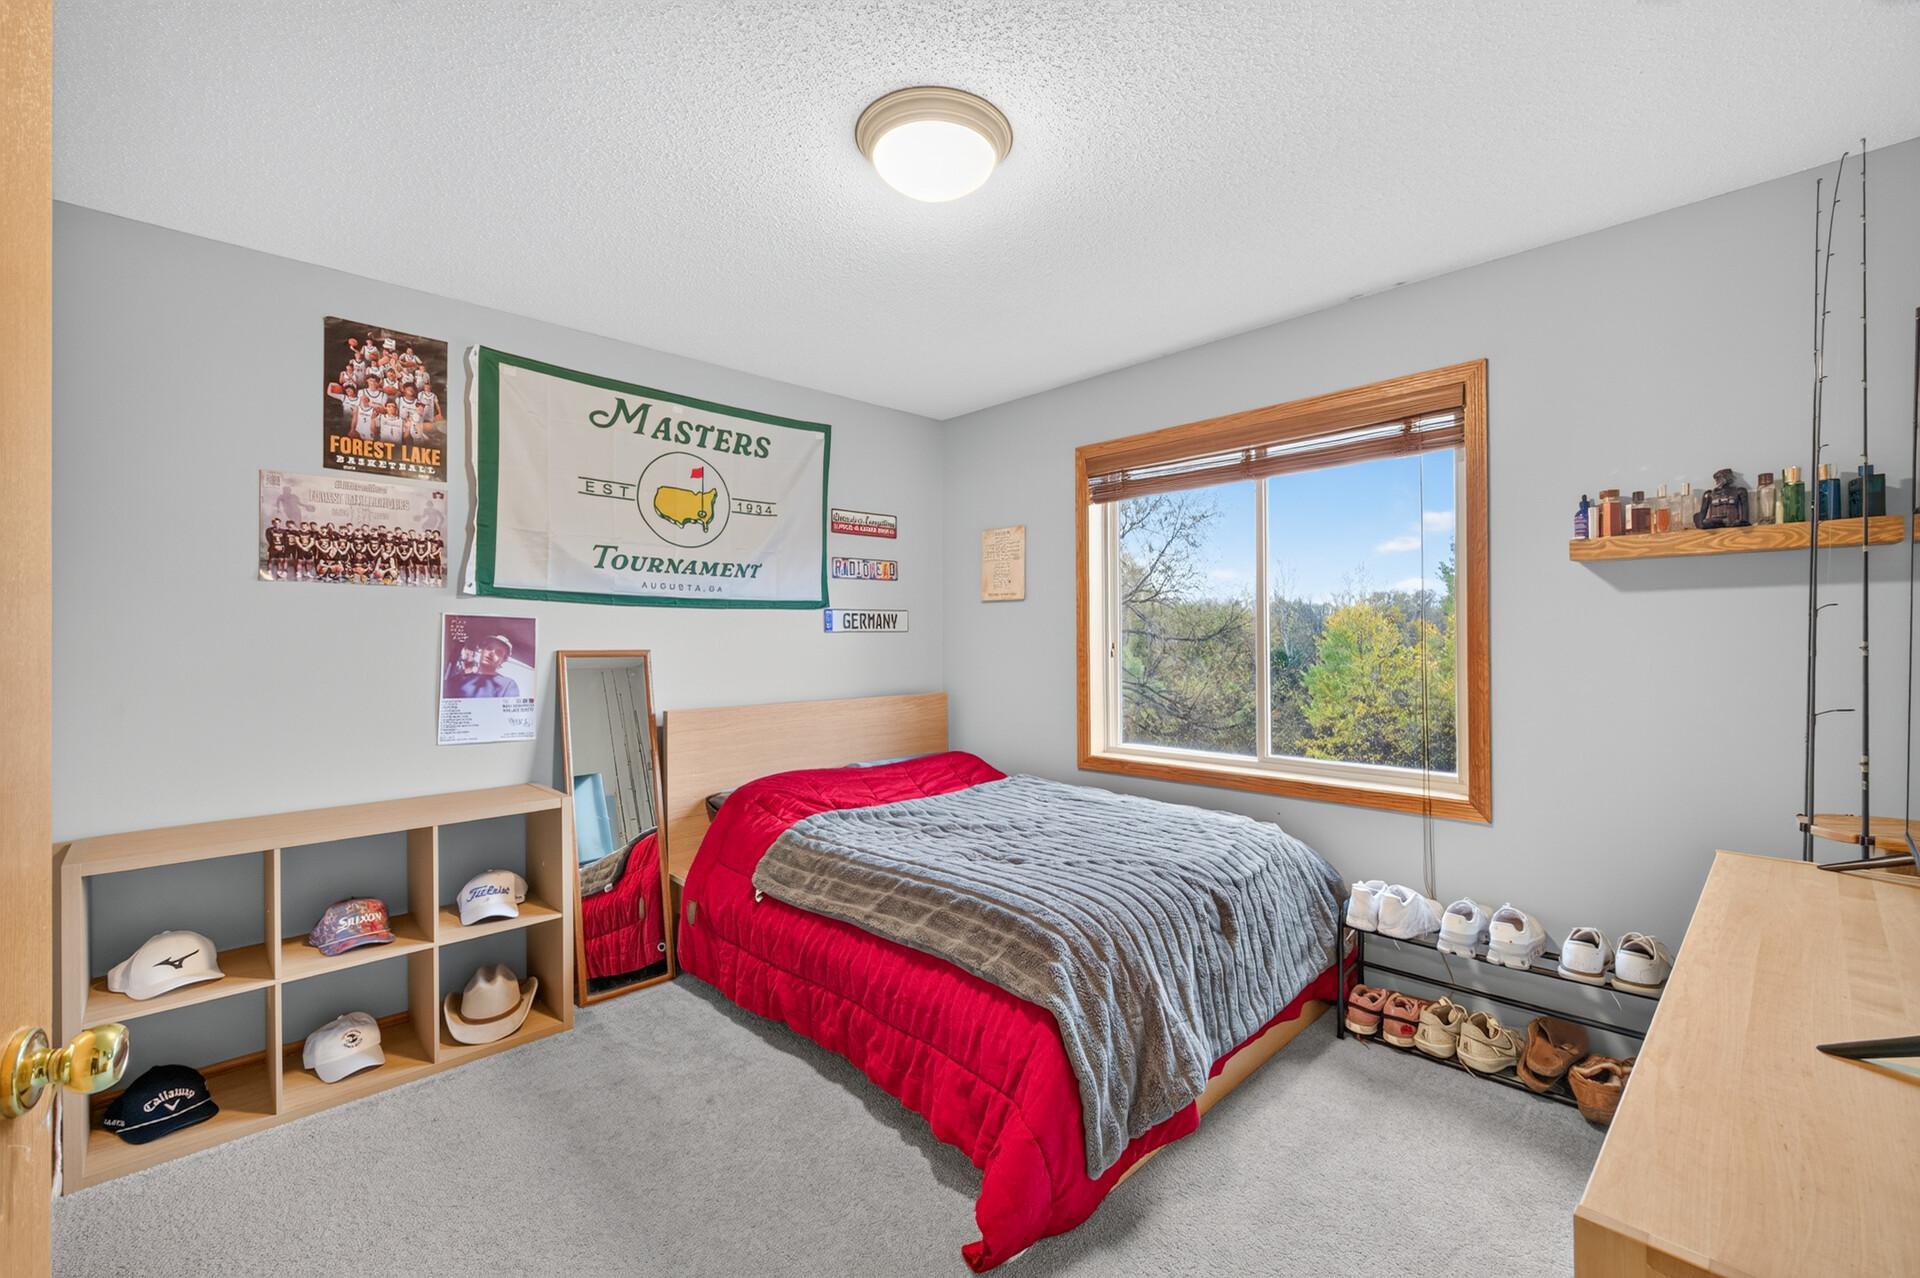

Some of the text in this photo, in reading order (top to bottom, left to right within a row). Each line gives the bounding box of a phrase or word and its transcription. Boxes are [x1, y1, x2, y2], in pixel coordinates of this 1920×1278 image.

[589, 398, 771, 459] MASTERS
[330, 435, 440, 466] FOREST LAKE
[336, 455, 436, 474] BASKETBALL
[585, 480, 630, 497] EST
[737, 502, 772, 515] 1934
[593, 545, 762, 579] TOURNAMENT
[843, 612, 898, 629] GERMANY
[143, 1088, 195, 1112] Callaway
